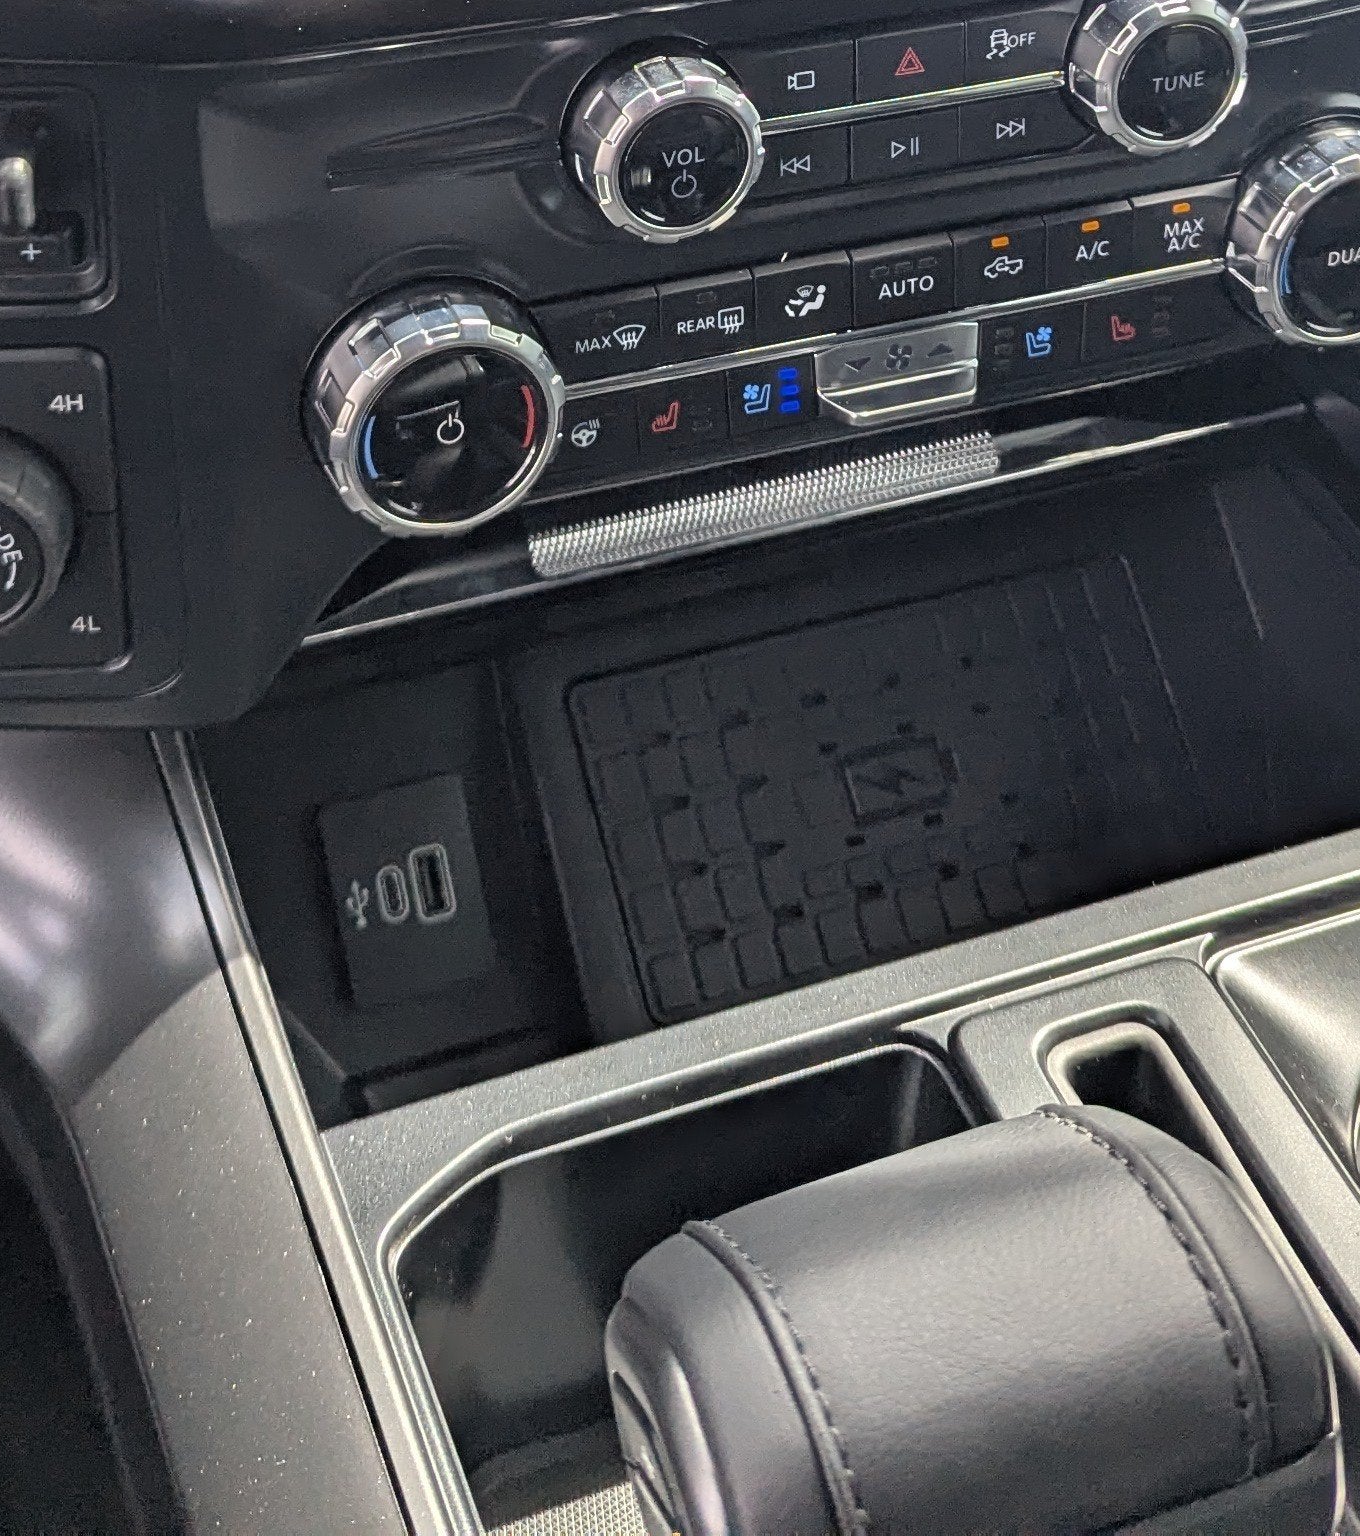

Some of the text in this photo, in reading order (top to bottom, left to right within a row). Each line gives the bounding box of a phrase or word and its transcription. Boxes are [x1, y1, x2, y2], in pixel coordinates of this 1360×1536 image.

[1007, 30, 1037, 48] OFF
[1152, 70, 1206, 94] TUNE
[661, 148, 706, 167] VOL
[1163, 218, 1205, 238] MAX
[1075, 240, 1110, 262] A/C
[1166, 232, 1202, 252] A/C
[878, 275, 935, 300] AUTO
[676, 316, 716, 335] REAR
[575, 334, 612, 354] MAX
[48, 394, 85, 414] 4H
[70, 615, 101, 633] 4L
